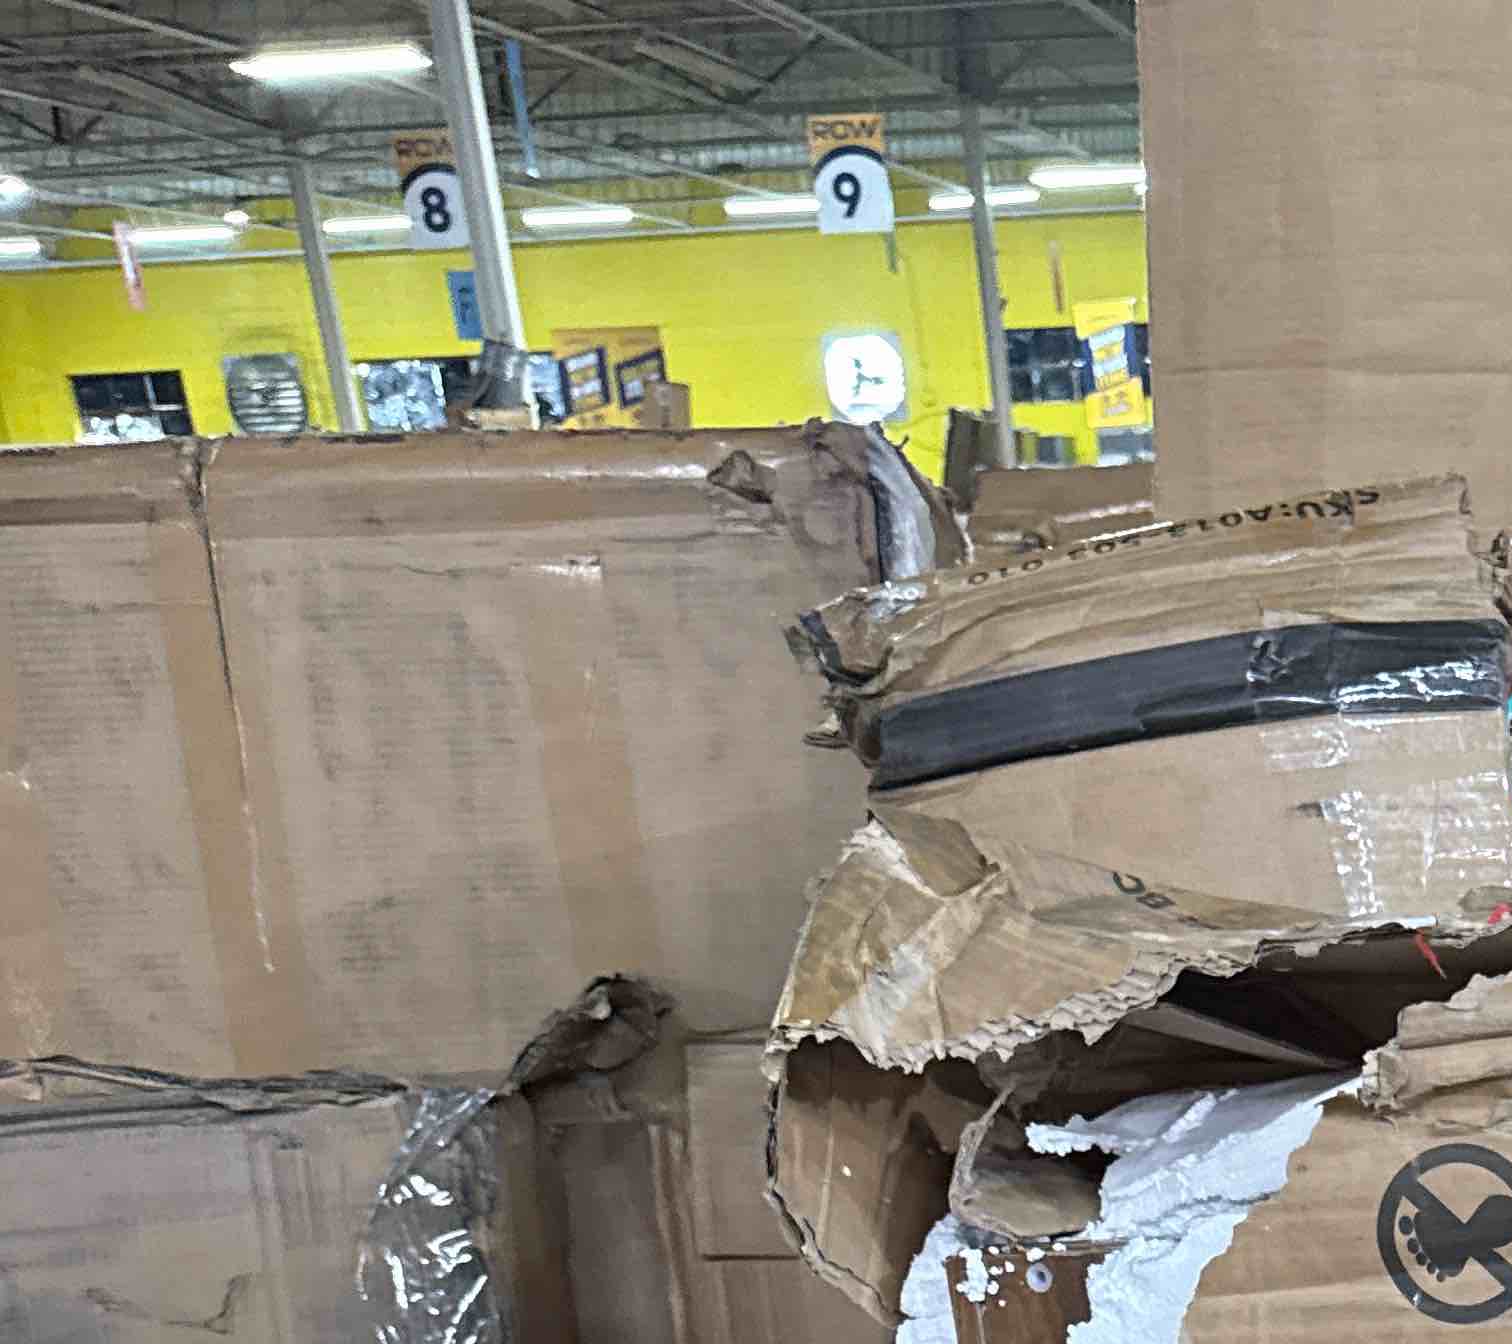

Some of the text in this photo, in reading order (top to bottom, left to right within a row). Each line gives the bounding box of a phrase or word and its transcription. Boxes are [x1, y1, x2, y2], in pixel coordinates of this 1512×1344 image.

[811, 121, 876, 139] ROW
[421, 187, 452, 233] 8
[832, 172, 861, 218] 9
